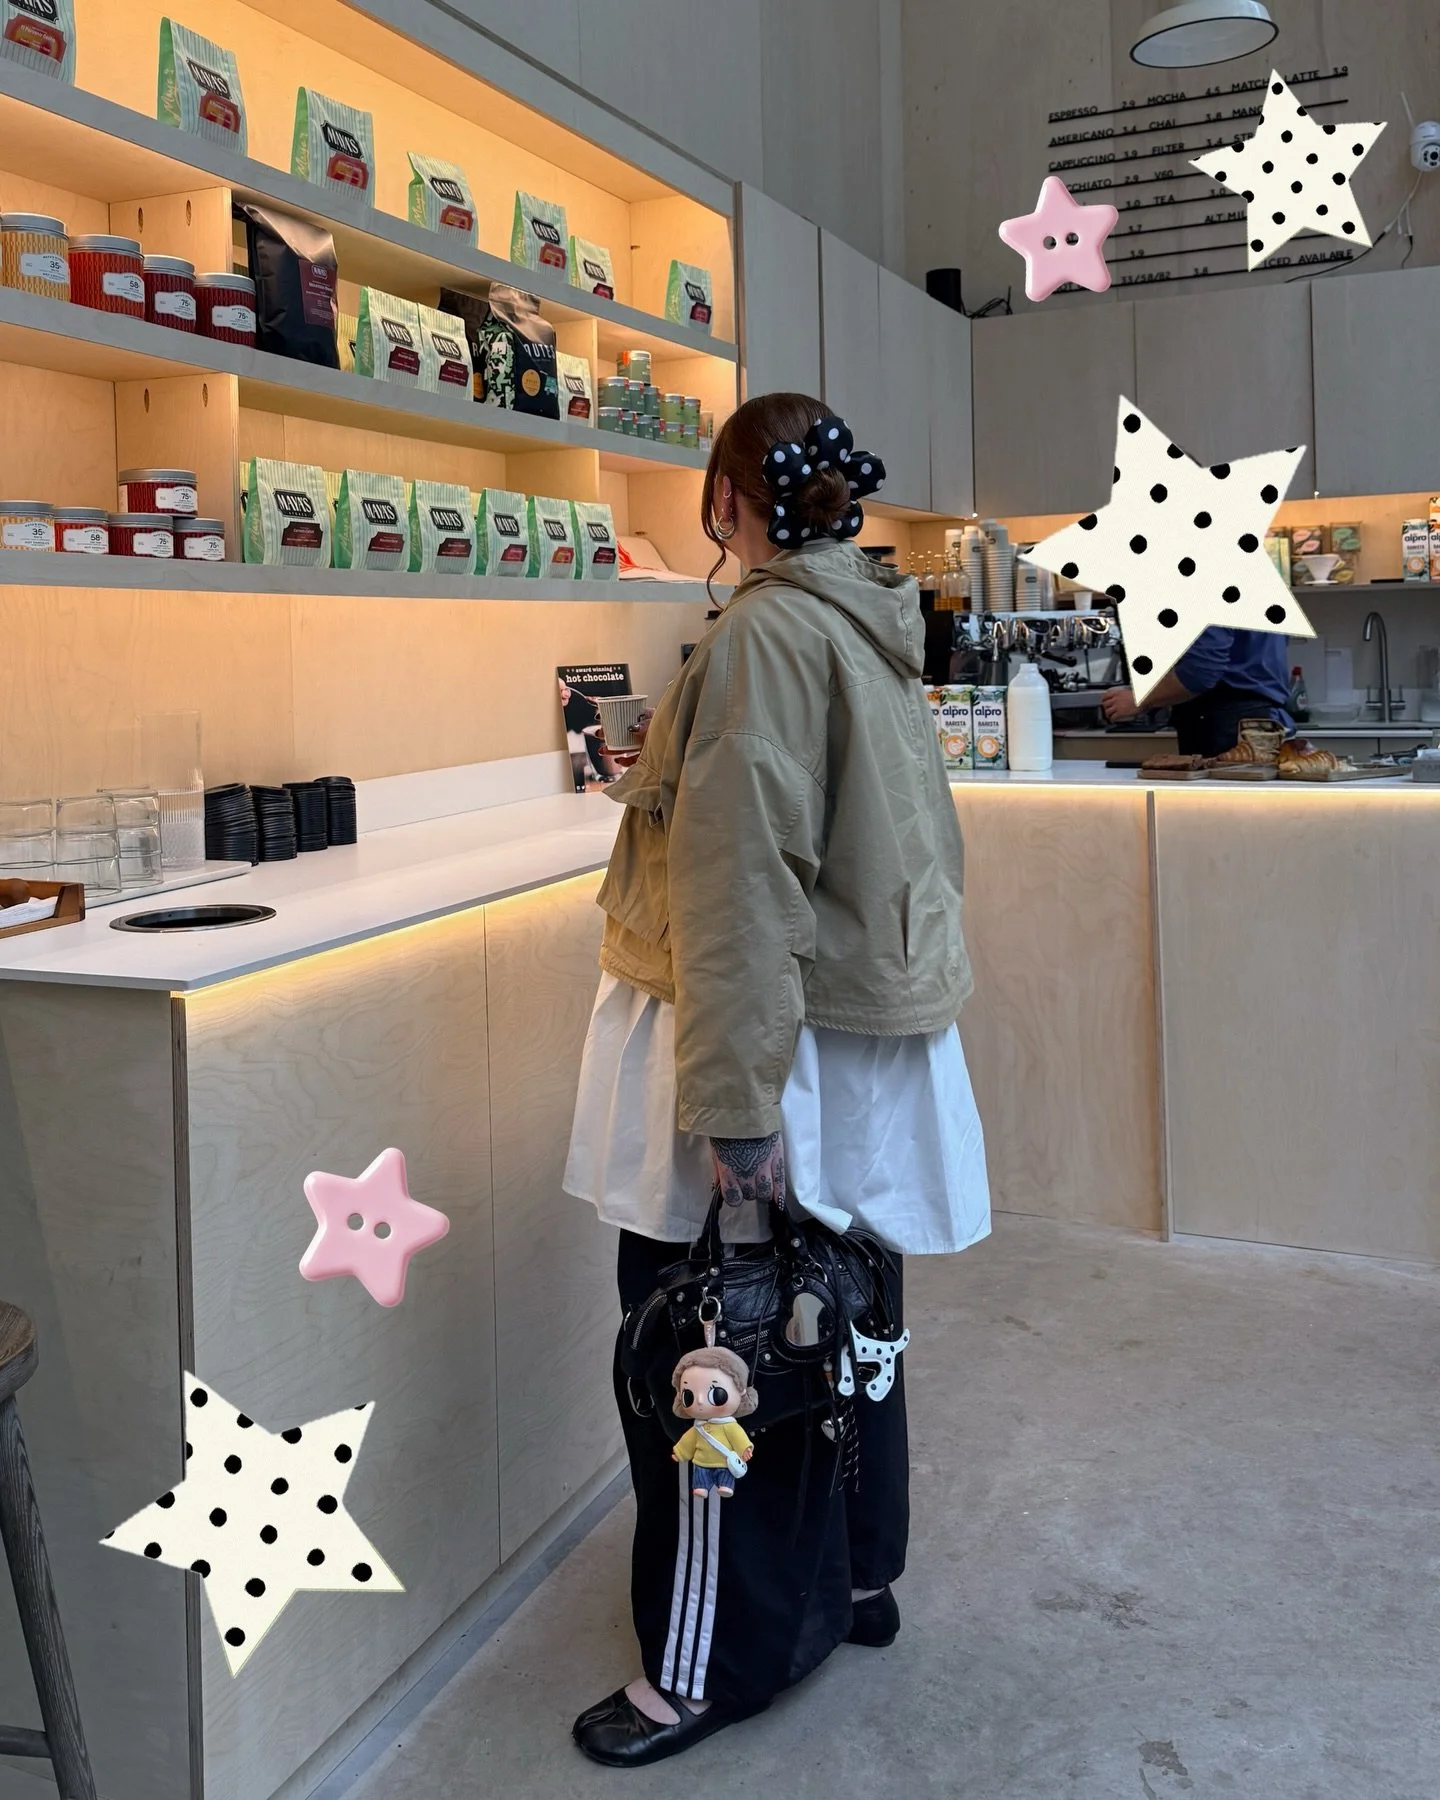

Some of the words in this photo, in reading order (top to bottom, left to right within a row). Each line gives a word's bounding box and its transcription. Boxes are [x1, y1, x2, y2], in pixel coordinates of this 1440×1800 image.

[1231, 77, 1271, 92] MATCH
[1147, 91, 1187, 105] MOCHA
[1048, 105, 1099, 121] ESPRESSO
[1149, 118, 1175, 132] CHAI
[1051, 128, 1115, 146] AMERICANO
[1152, 142, 1184, 155] FILTER
[1048, 153, 1115, 170] CAPPUCCINO
[1154, 169, 1173, 181] V60
[1153, 194, 1175, 207] TEA
[1204, 212, 1224, 224] ALT
[1263, 257, 1291, 268] ICED
[1299, 249, 1354, 264] AVAILABLE
[276, 494, 312, 513] MAYA'S
[363, 503, 397, 522] MAYA'S
[432, 511, 463, 528] MAYA'S
[1404, 534, 1427, 543] alpro
[566, 674, 582, 683] hot
[583, 672, 625, 682] chocolate
[942, 706, 969, 718] alpro
[975, 706, 1002, 718] alpro
[945, 720, 967, 728] BARISTA
[978, 720, 1000, 728] BARISTA
